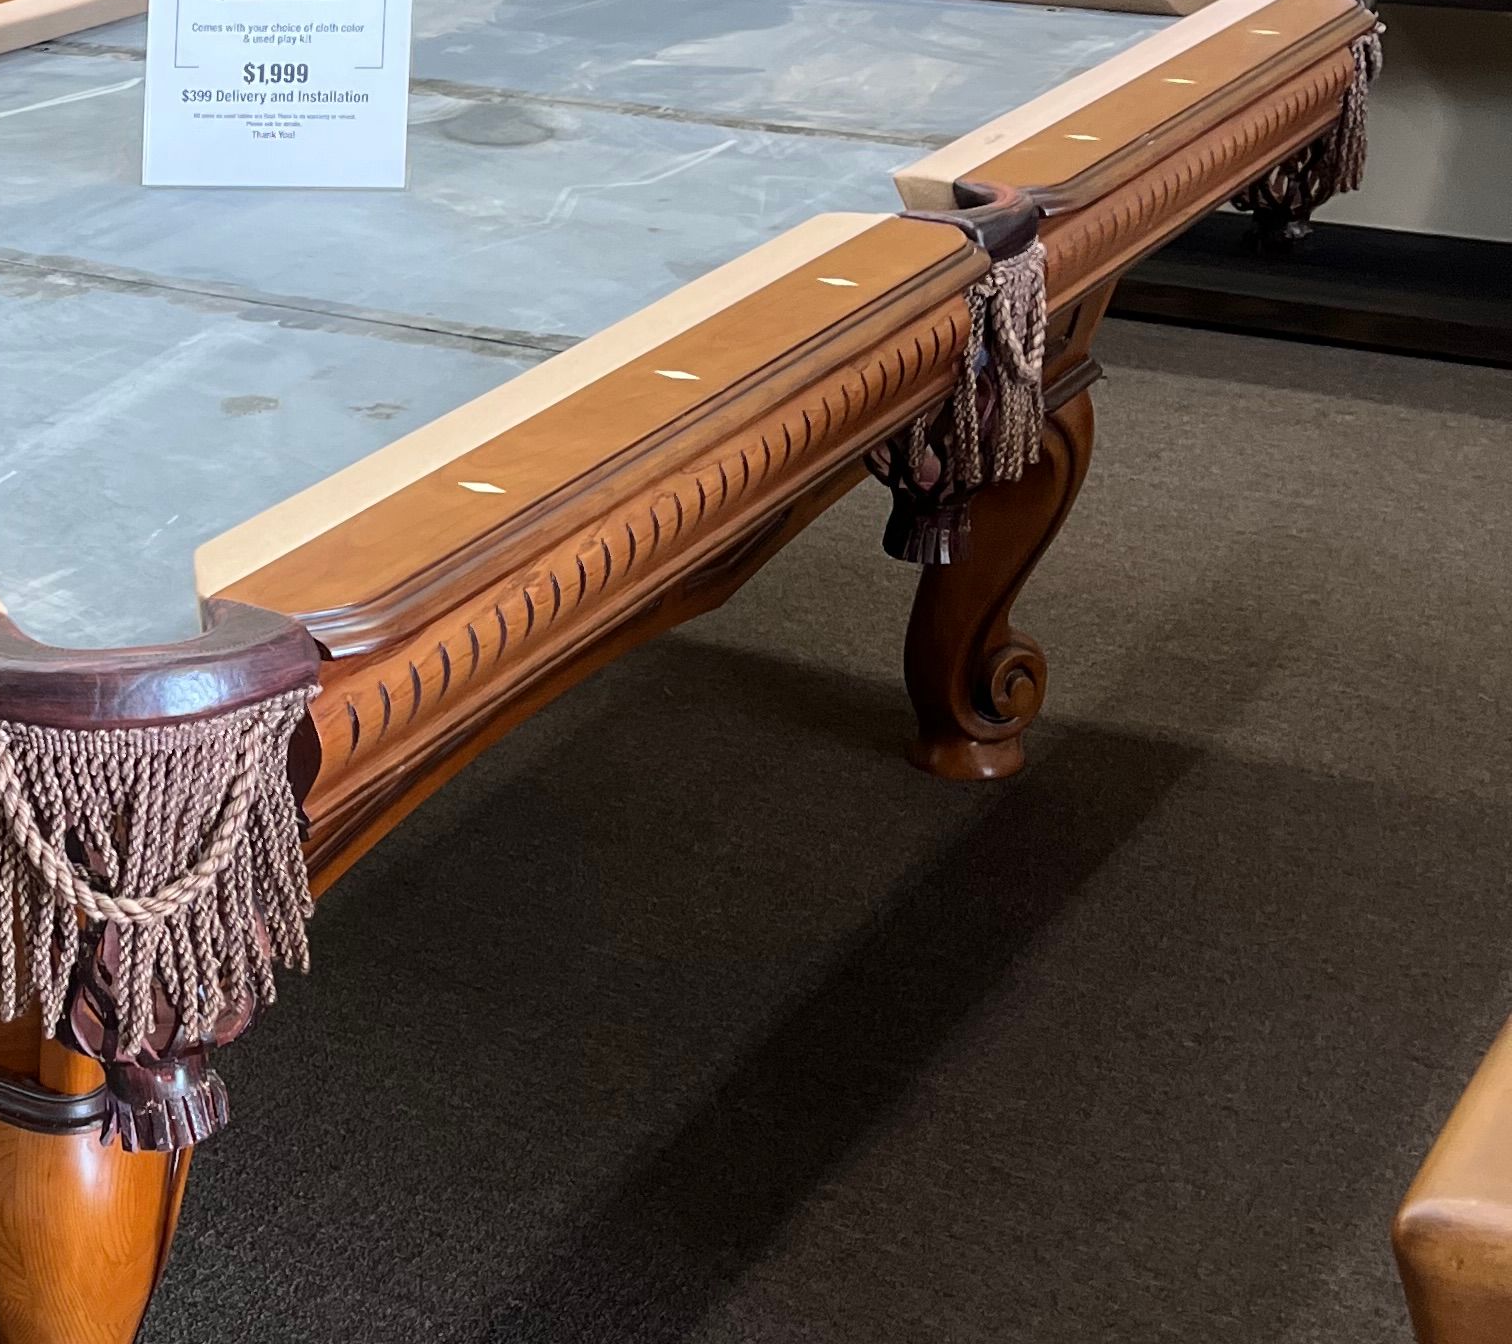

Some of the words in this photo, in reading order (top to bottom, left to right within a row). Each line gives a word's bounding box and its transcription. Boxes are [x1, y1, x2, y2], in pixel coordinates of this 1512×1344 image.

[191, 22, 223, 33] Comes
[225, 23, 246, 33] with
[248, 24, 269, 35] your
[270, 22, 302, 33] choice
[303, 22, 314, 33] of
[315, 23, 339, 33] cloth
[340, 23, 365, 33] color
[242, 34, 251, 44] &
[252, 34, 276, 44] used
[277, 34, 297, 46] play
[299, 34, 312, 44] kit
[243, 61, 309, 85] $1,999
[181, 89, 213, 103] $399
[215, 89, 267, 105] Delivery
[270, 90, 294, 103] and
[298, 90, 369, 103] Installation
[252, 130, 277, 139] Thank
[278, 130, 296, 139] You!
